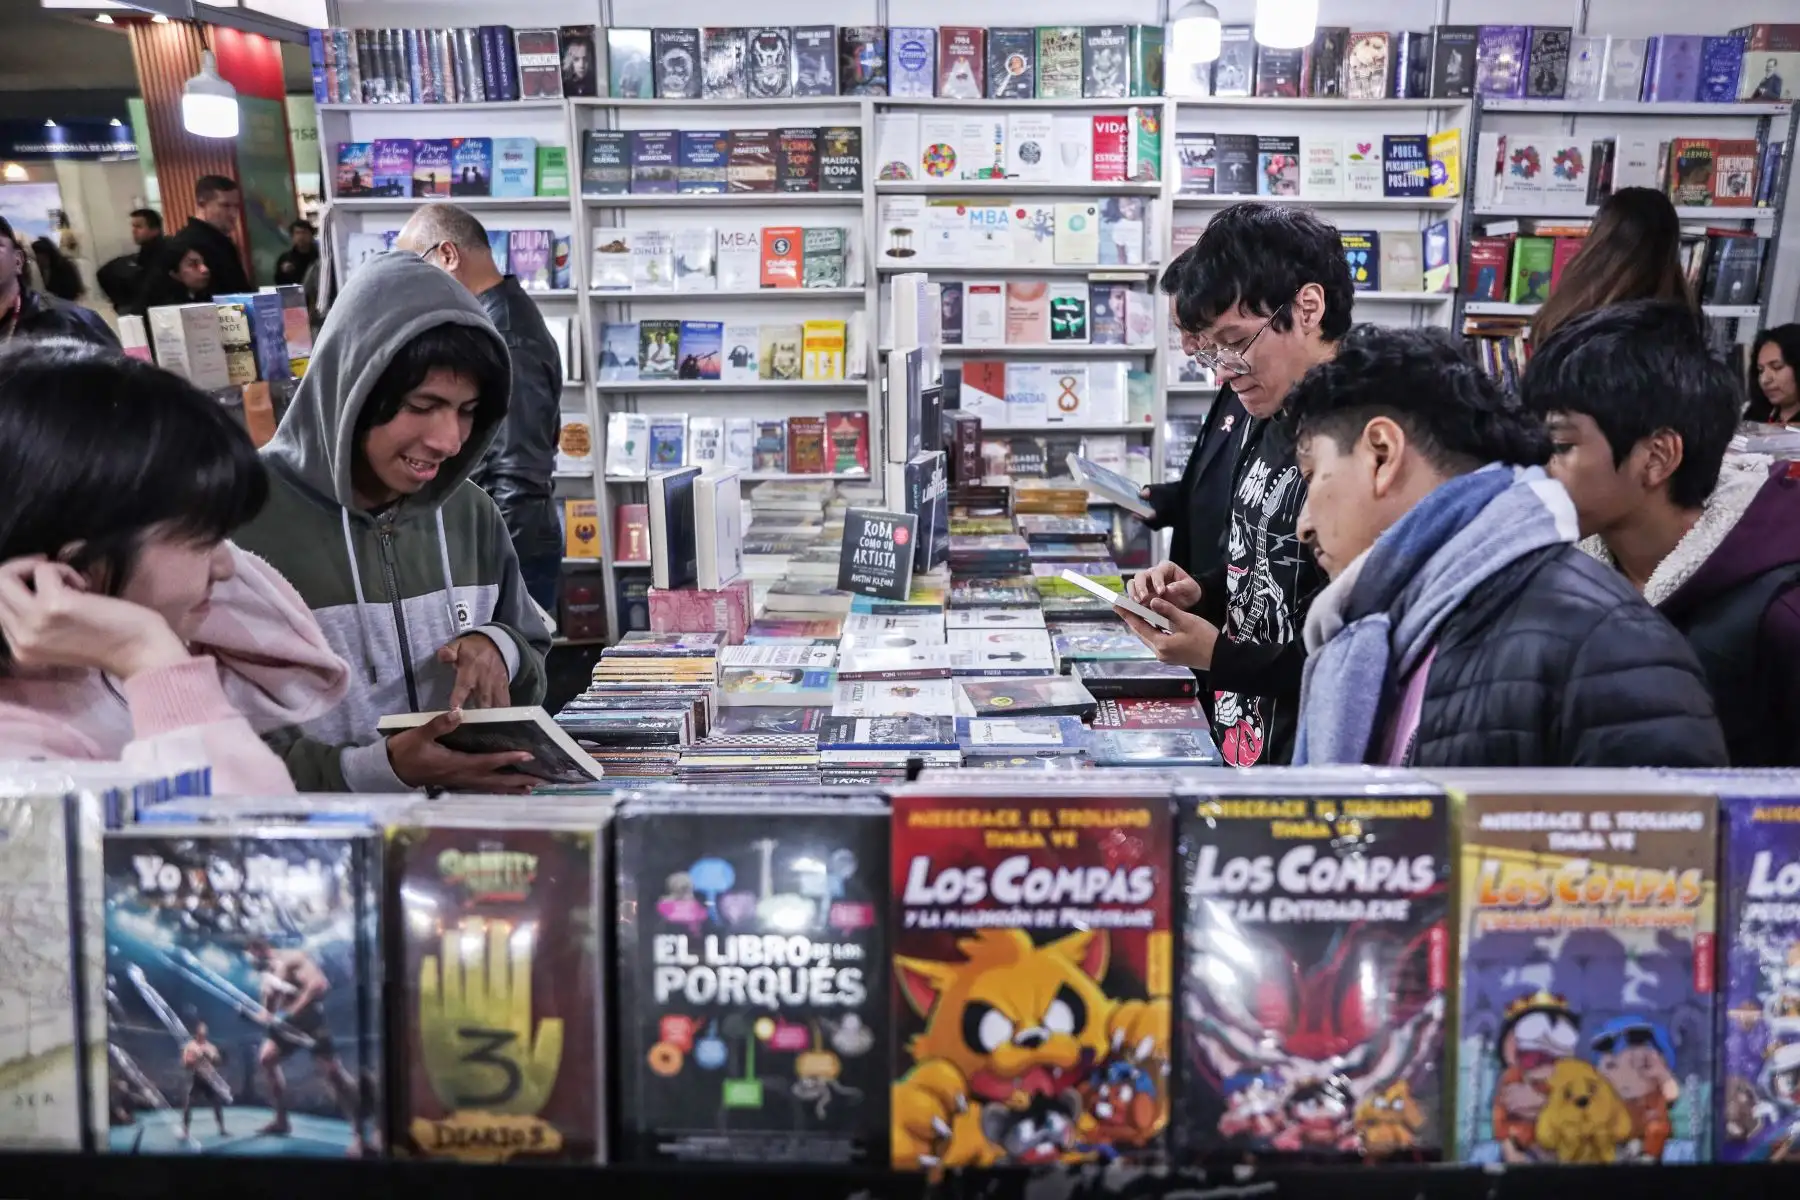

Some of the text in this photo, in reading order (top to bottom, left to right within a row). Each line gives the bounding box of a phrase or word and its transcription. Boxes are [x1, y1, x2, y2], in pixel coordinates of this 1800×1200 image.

[824, 166, 857, 175] ROMA
[969, 210, 1009, 226] MBA
[510, 231, 549, 250] CULPA
[721, 232, 758, 246] MBA
[864, 520, 893, 540] ROBA
[859, 537, 894, 551] COMO UN
[853, 548, 896, 569] ARTISTA
[851, 574, 894, 587] AUSTIN KLEON
[919, 909, 941, 928] LA
[653, 934, 699, 966] EL
[704, 934, 811, 966] LIBRO
[654, 957, 867, 1009] PORQUÉS
[457, 1026, 523, 1110] 3
